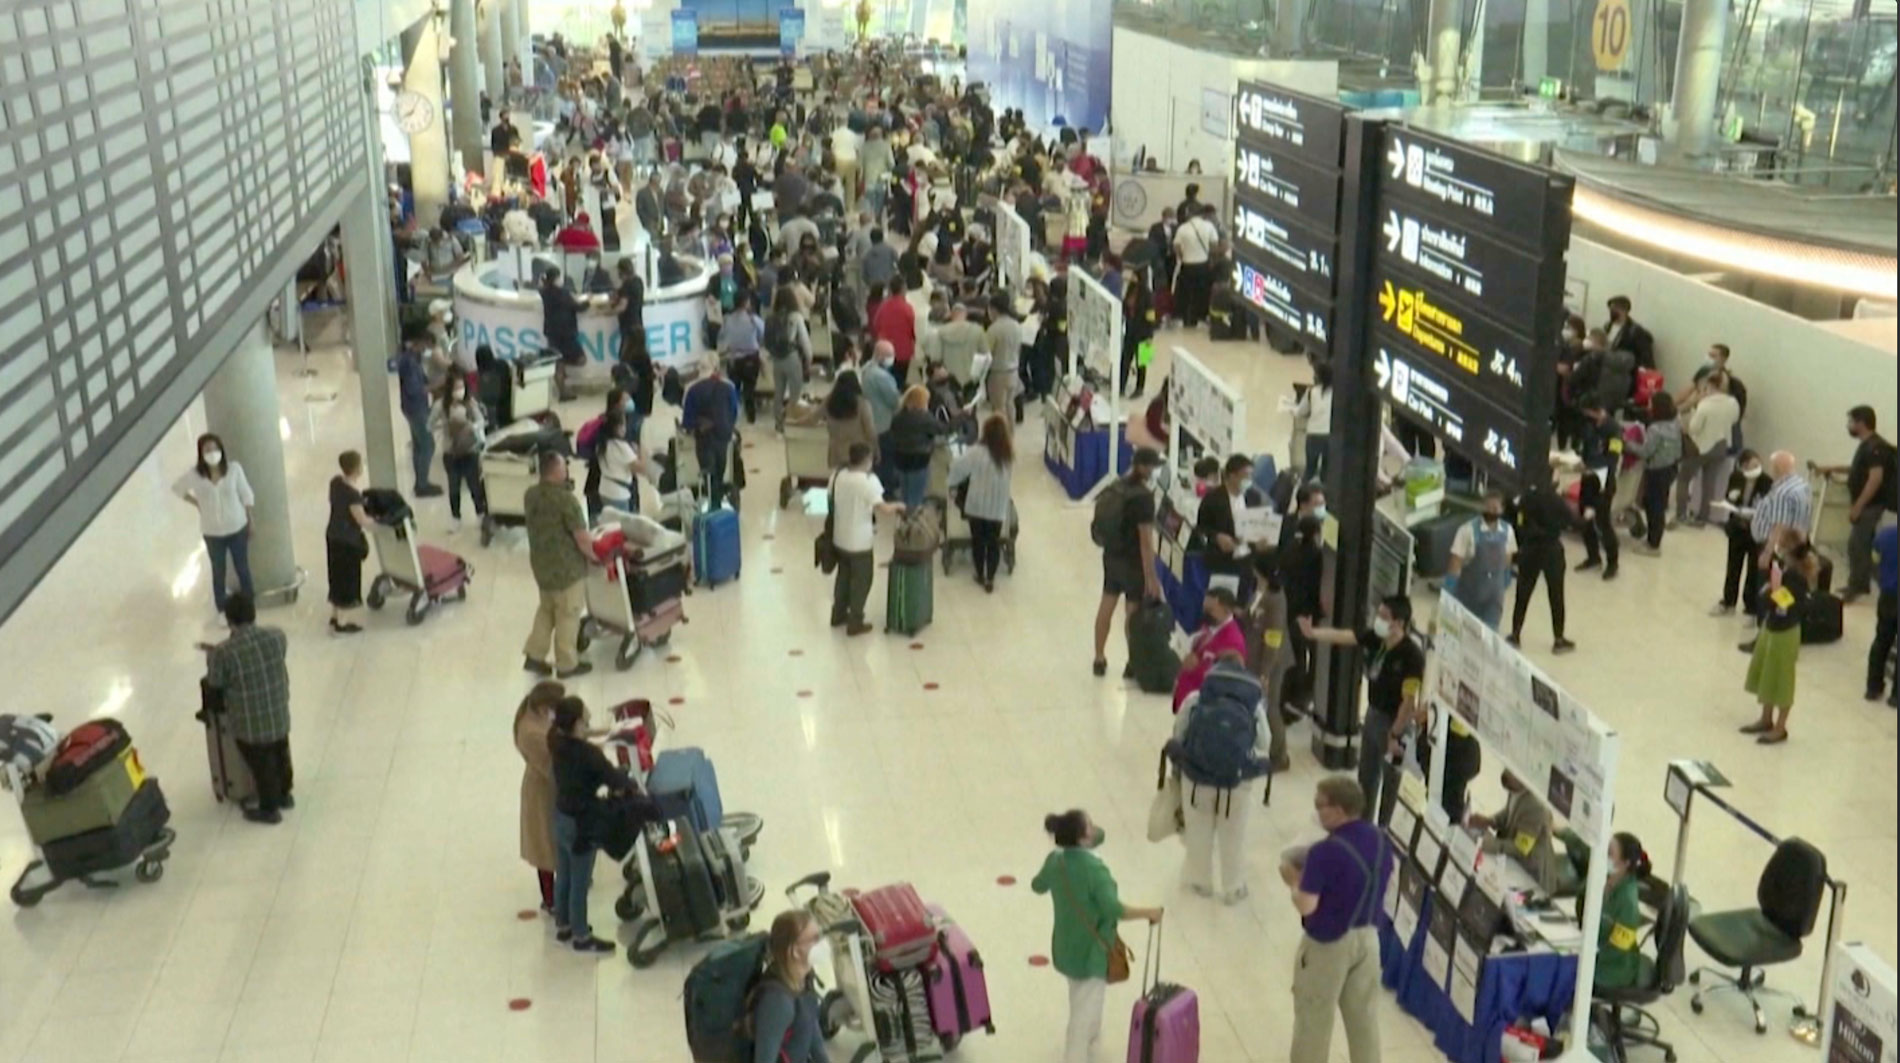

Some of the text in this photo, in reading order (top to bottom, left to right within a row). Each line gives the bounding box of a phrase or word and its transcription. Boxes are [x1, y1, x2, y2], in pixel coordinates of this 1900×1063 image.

[1598, 4, 1627, 57] 10
[462, 317, 692, 363] PASSNER
[1838, 1020, 1874, 1062] Hilton
